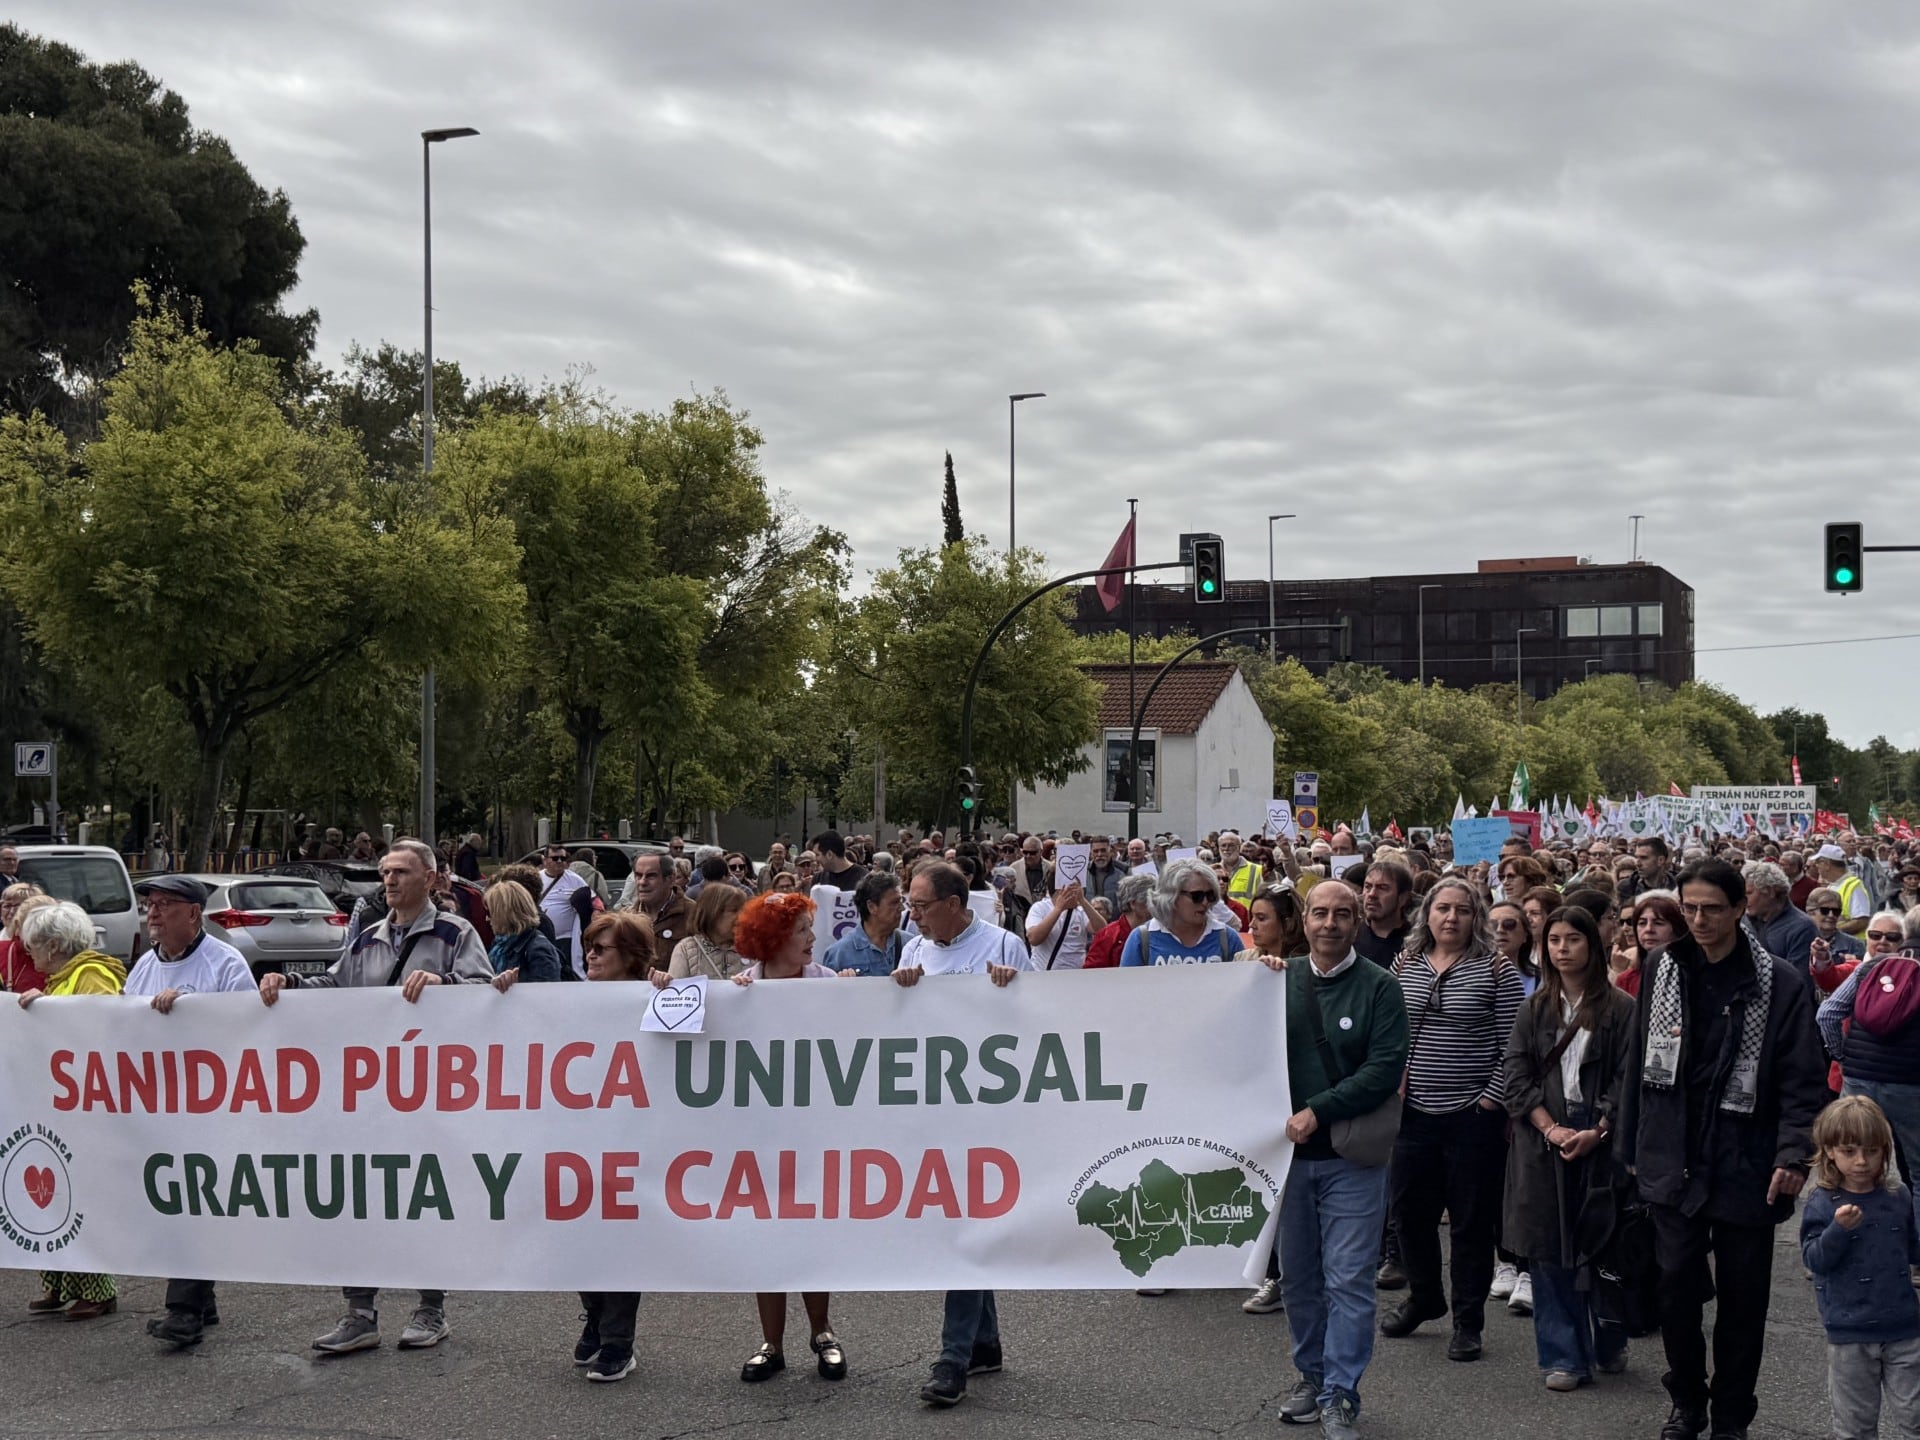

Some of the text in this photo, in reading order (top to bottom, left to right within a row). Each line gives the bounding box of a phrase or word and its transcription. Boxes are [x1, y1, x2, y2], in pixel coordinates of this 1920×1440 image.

[1744, 788, 1781, 799] NÚÑEZ
[1783, 790, 1805, 799] POR
[1767, 801, 1813, 811] PÚBLICA
[50, 1028, 1148, 1114] SANIDAD PÚBLICA UNIVERSAL,
[0, 1123, 73, 1164] MAREA BLANCA
[143, 1147, 1022, 1221] GRATUITA Y DE CALIDAD
[1067, 1145, 1130, 1206] COORDINADORA
[1131, 1136, 1185, 1151] ANDALUZA
[1187, 1137, 1201, 1147] DE
[1203, 1140, 1246, 1164] MAREAS
[0, 1206, 84, 1253] ÓRDOBA CAPITAL
[1209, 1206, 1254, 1218] CAMB
